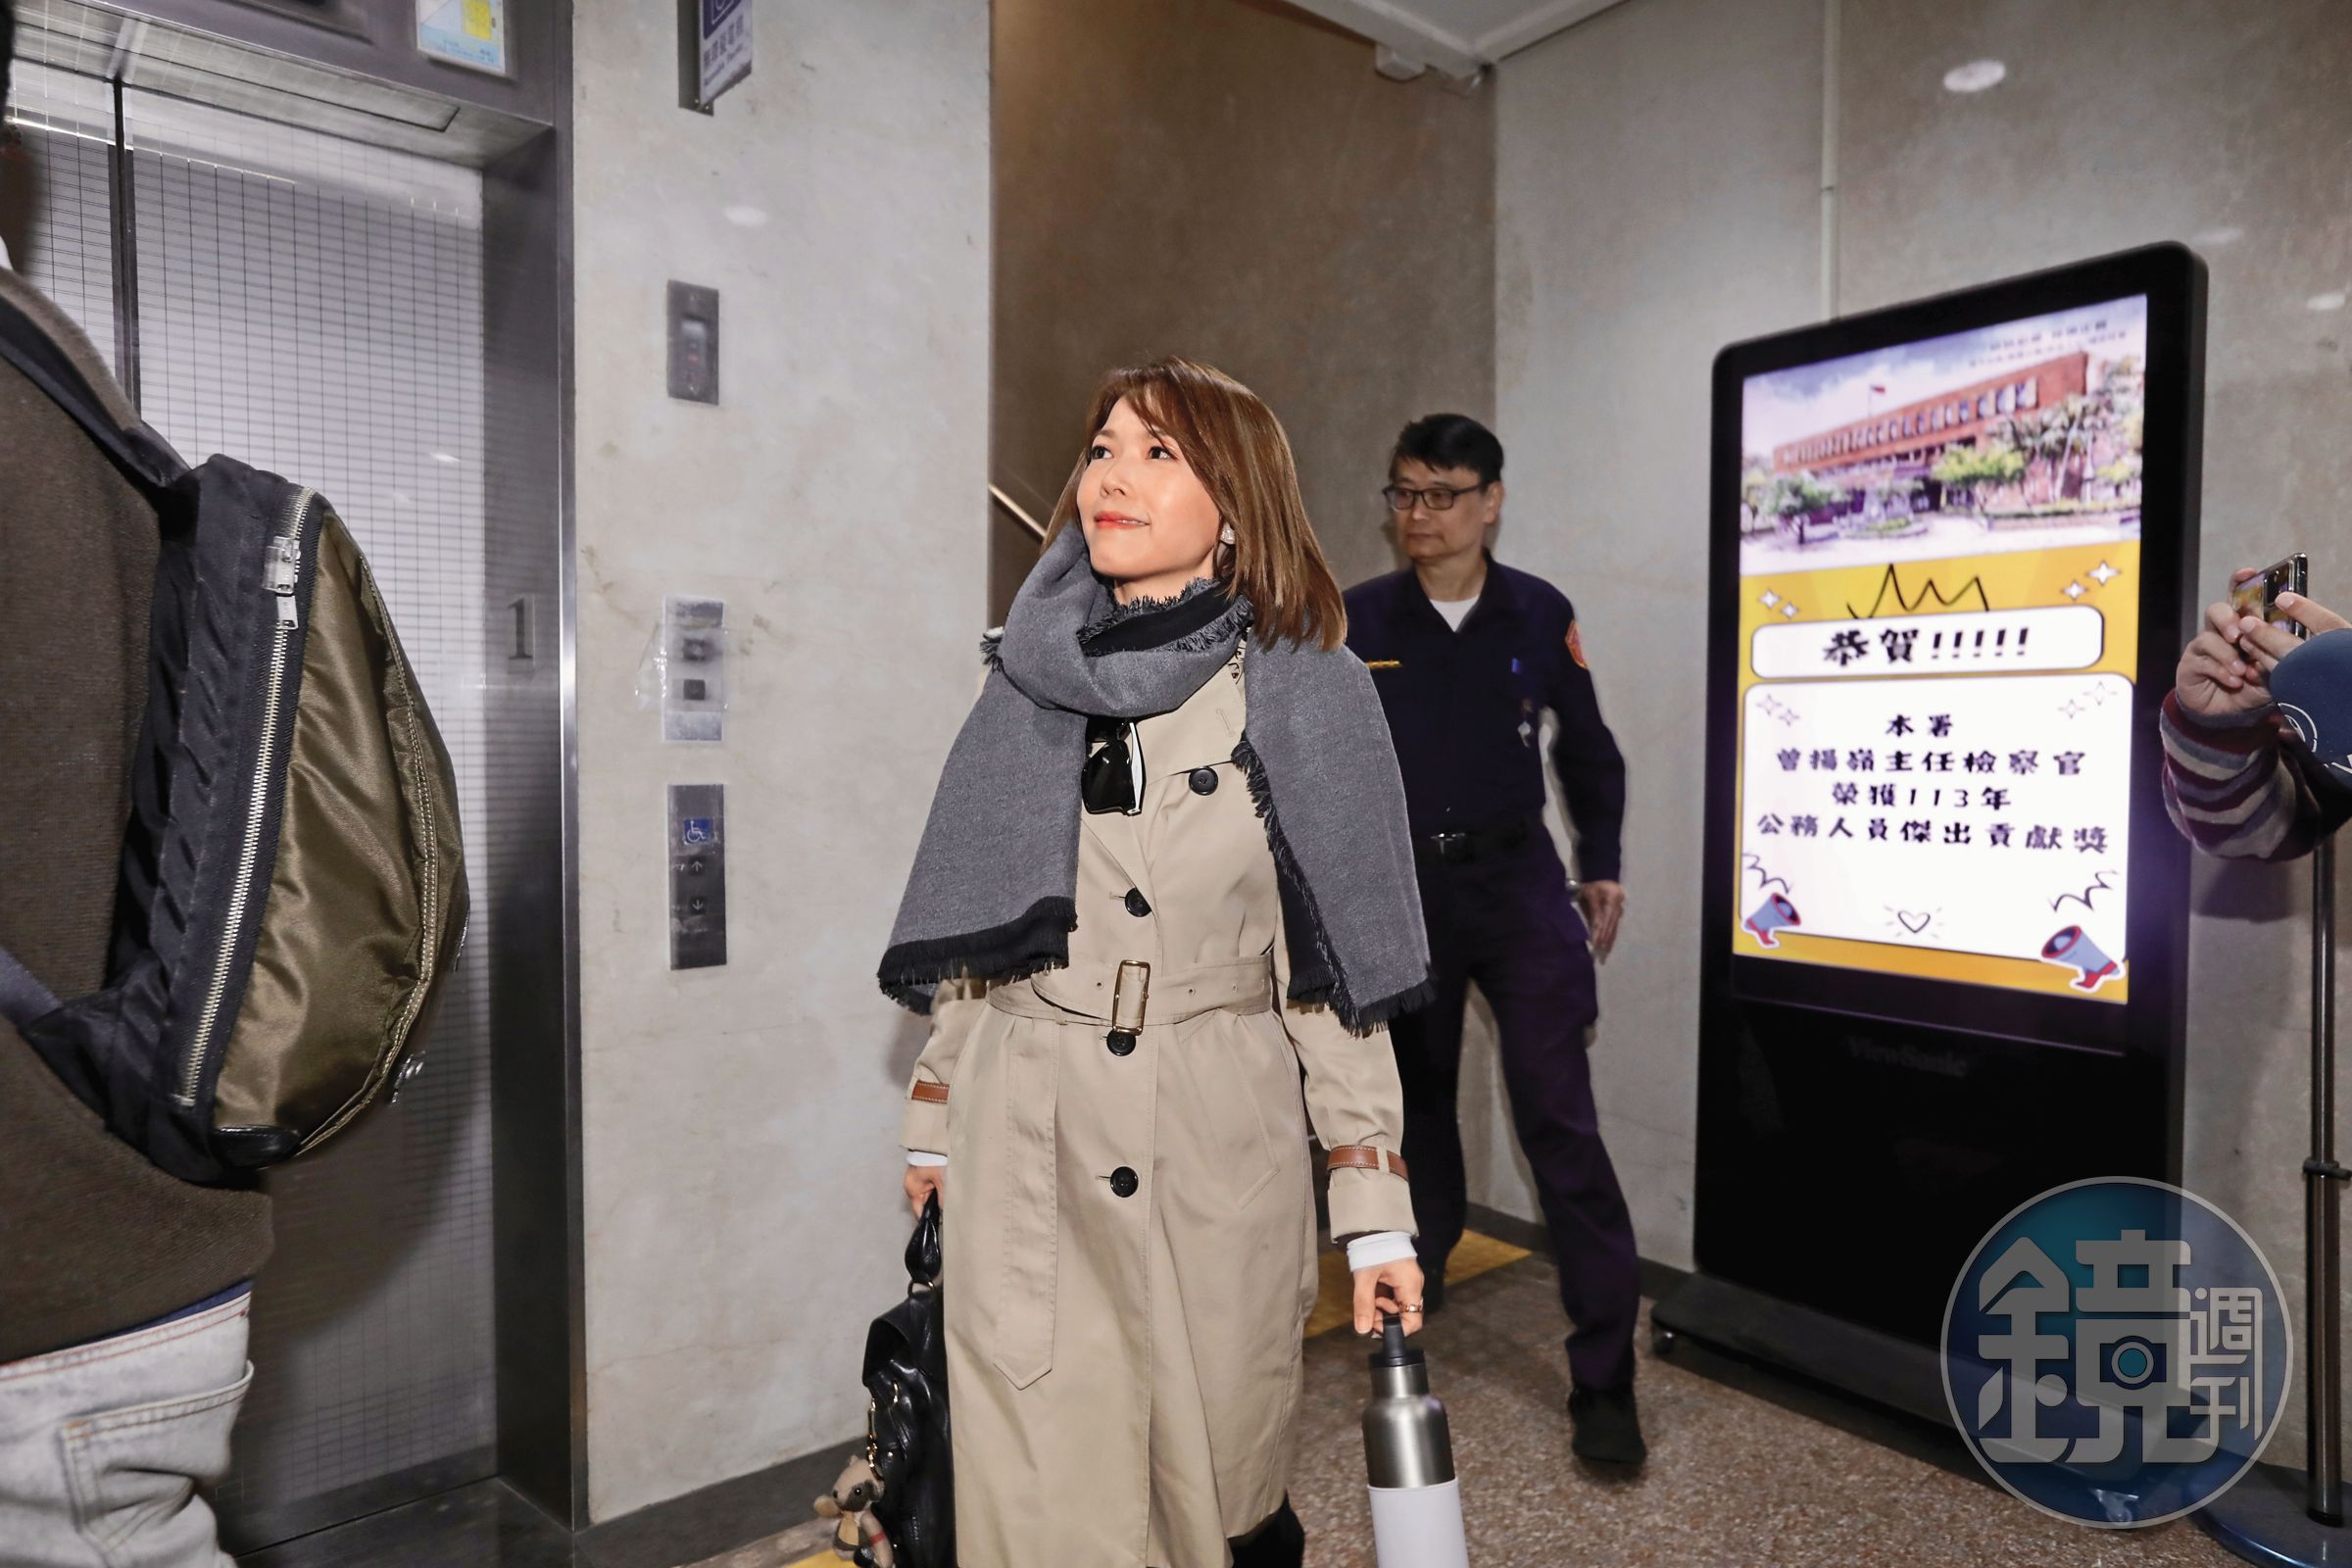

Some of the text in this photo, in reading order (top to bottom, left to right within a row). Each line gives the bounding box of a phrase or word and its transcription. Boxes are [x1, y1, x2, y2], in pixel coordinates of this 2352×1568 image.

[1886, 713, 1953, 738] 本署
[1832, 781, 2012, 811] 榮獲113年
[1756, 812, 2110, 855] 公務人員傑出貢獻獎
